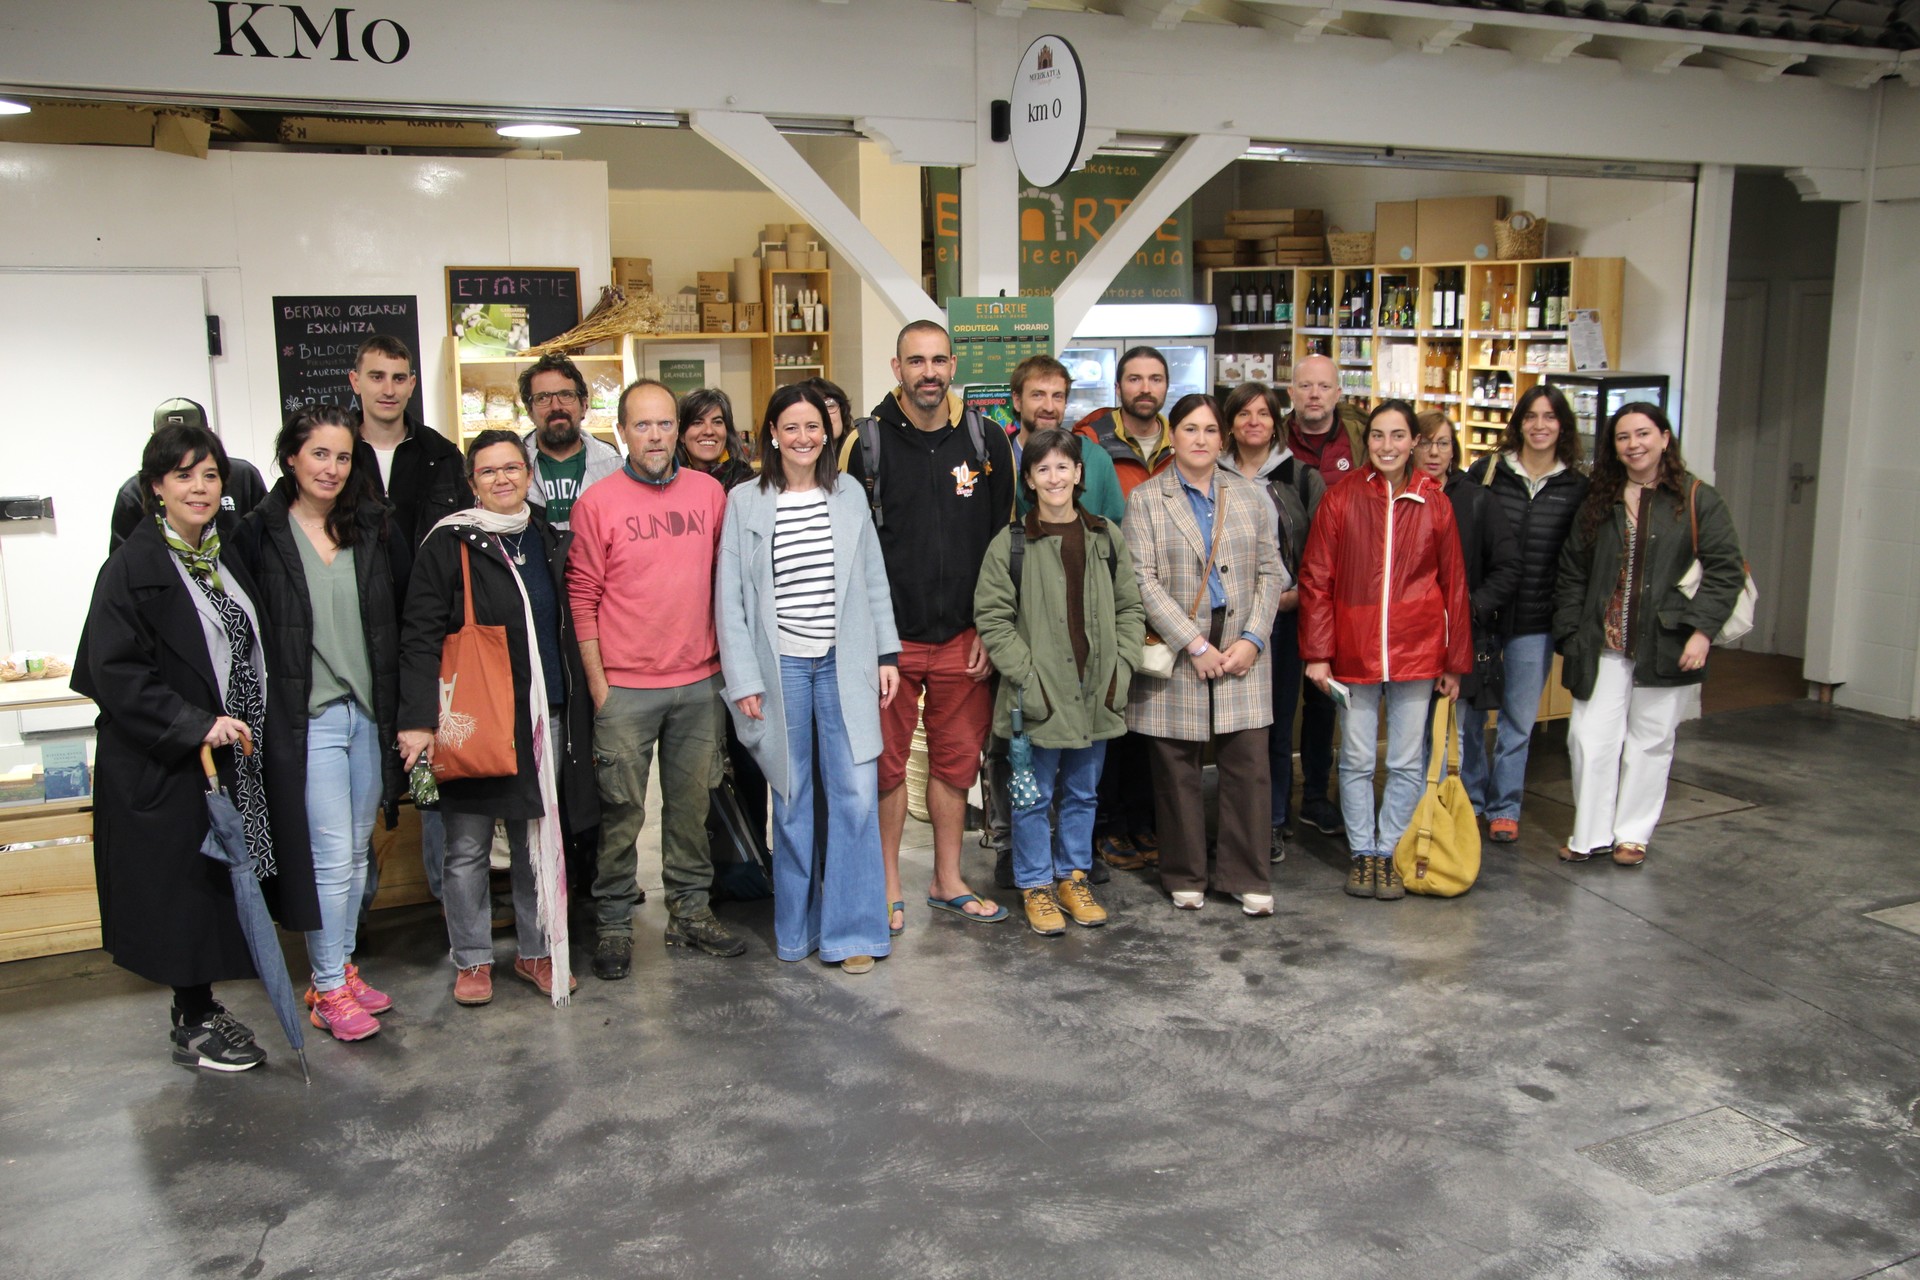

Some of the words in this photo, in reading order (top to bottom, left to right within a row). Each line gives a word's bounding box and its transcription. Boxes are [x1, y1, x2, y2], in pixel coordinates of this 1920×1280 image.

[1028, 103, 1048, 122] km
[284, 305, 340, 319] BERTAKO
[348, 304, 407, 317] OKELAREN
[954, 324, 999, 332] ORDUTEGIA
[1014, 323, 1049, 331] HORARIO
[625, 510, 706, 541] SUNDAY
